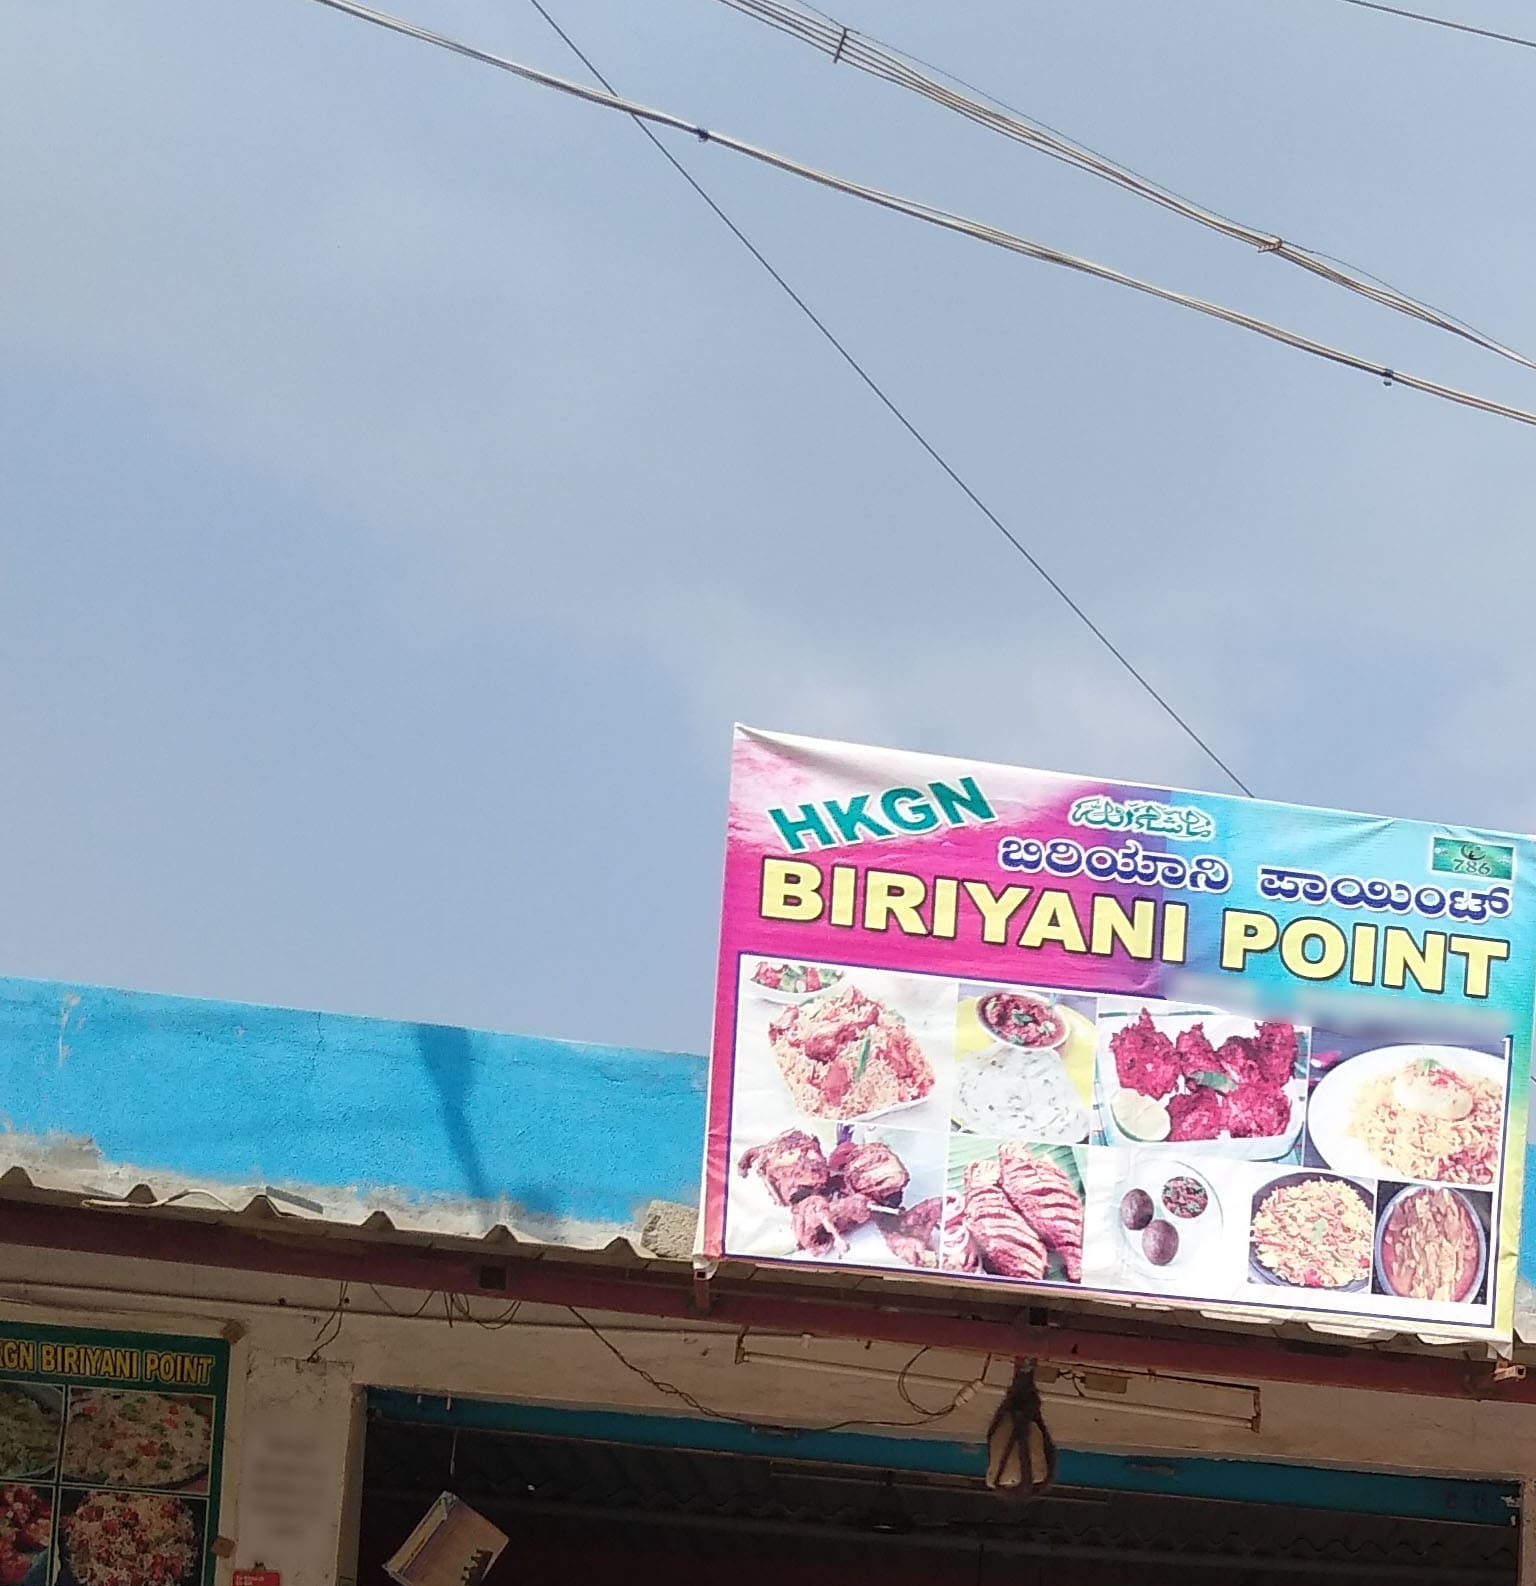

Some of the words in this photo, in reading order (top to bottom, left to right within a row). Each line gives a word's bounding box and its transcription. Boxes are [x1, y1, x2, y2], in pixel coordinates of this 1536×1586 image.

[766, 775, 998, 852] HKGN
[1000, 837, 1231, 893] ಬಿರಿಯಾನಿ
[1258, 866, 1512, 922] ಪಾಯಿಂಟ್
[1453, 858, 1491, 876] 786
[759, 855, 1190, 965] BIRIYANI
[1219, 906, 1512, 999] POINT
[40, 1342, 139, 1380] BIRIYANI
[144, 1350, 215, 1385] POINT
